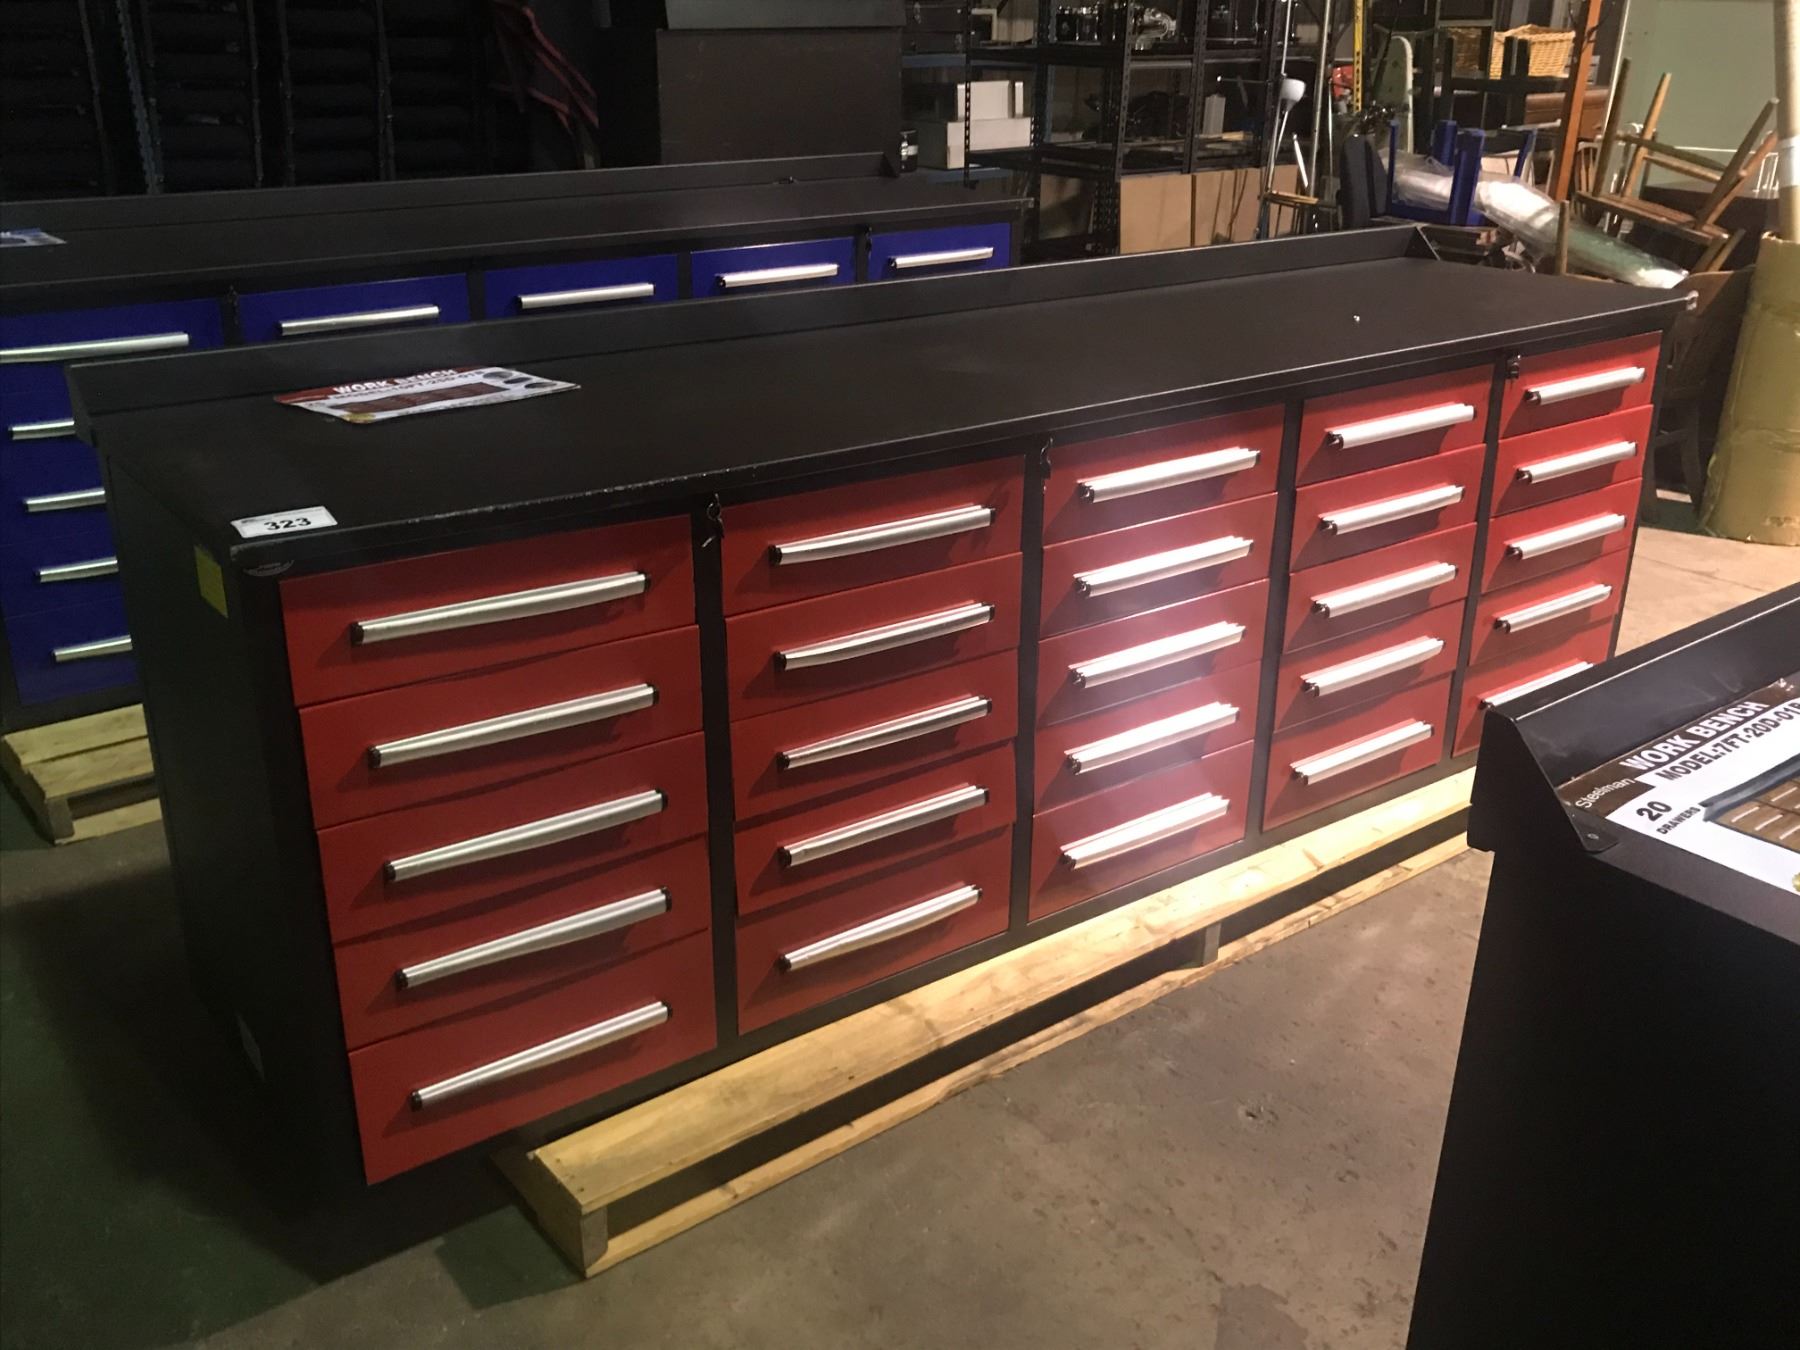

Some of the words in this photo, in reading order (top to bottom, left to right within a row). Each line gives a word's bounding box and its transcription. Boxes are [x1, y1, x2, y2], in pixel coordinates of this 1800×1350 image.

[333, 381, 388, 394] WORK
[264, 517, 311, 531] 323
[1619, 735, 1700, 771] WORK
[1686, 701, 1770, 738] BENCH
[1575, 777, 1636, 809] Steelman
[1636, 801, 1672, 822] 20
[1656, 806, 1701, 835] DRAWERS
